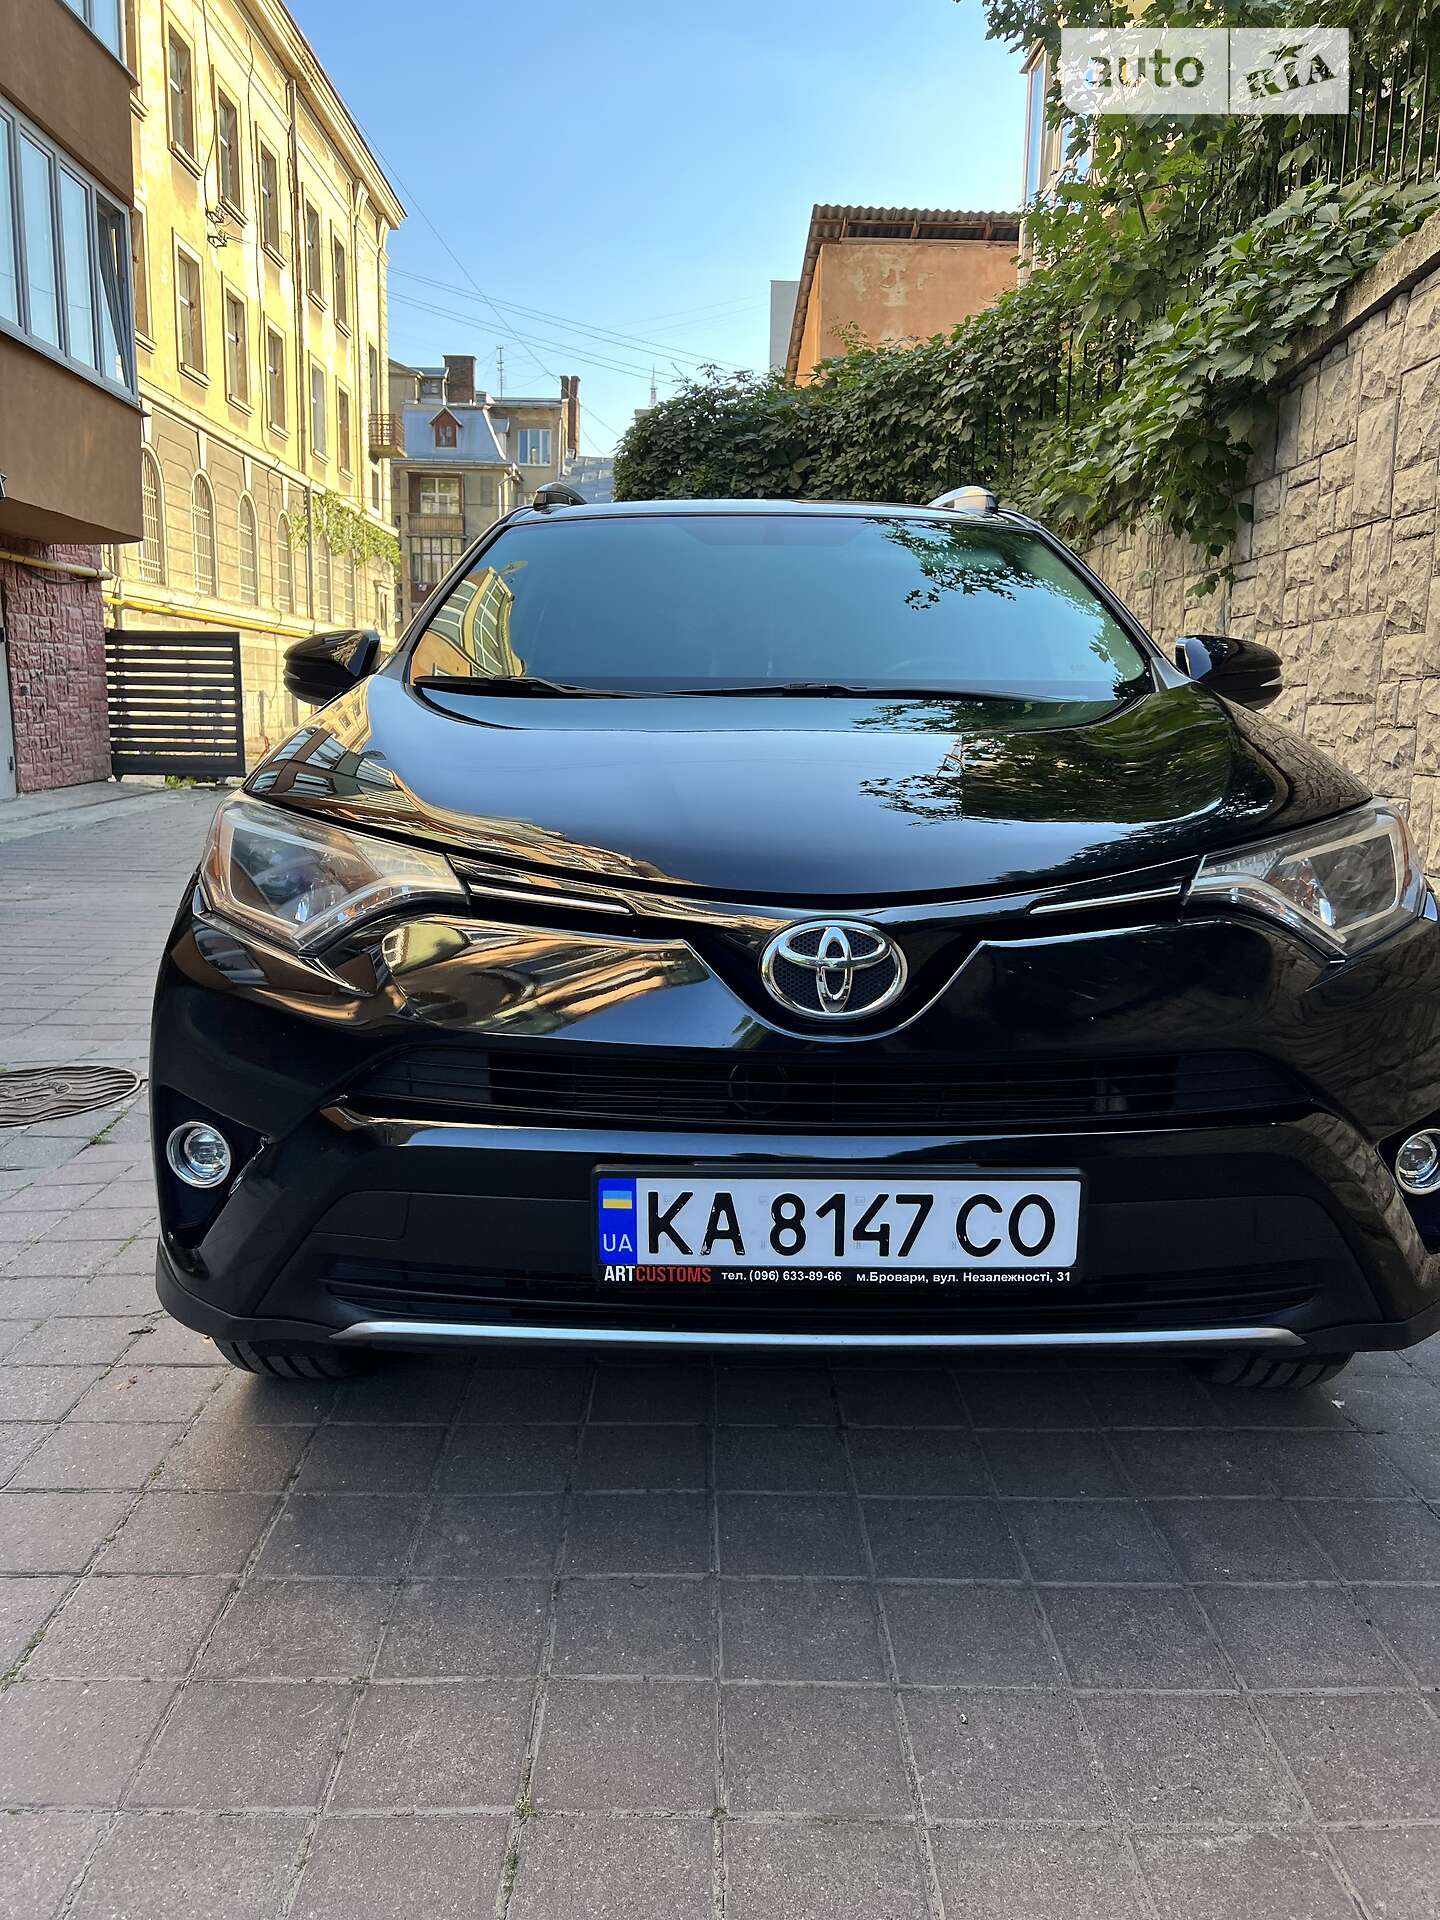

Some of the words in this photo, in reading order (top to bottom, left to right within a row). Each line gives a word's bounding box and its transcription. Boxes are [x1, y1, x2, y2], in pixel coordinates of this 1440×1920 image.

[647, 1191, 746, 1256] KA
[769, 1192, 934, 1258] 8147
[955, 1193, 1056, 1258] CO
[602, 1233, 633, 1252] UA
[721, 1270, 747, 1281] тел.
[749, 1269, 780, 1283] (096)
[782, 1270, 843, 1282] 633-89-66
[856, 1271, 929, 1285] м.Бровари,
[932, 1273, 959, 1285] вул.
[963, 1271, 1053, 1284] Незалежності,
[1056, 1271, 1072, 1282] 31
